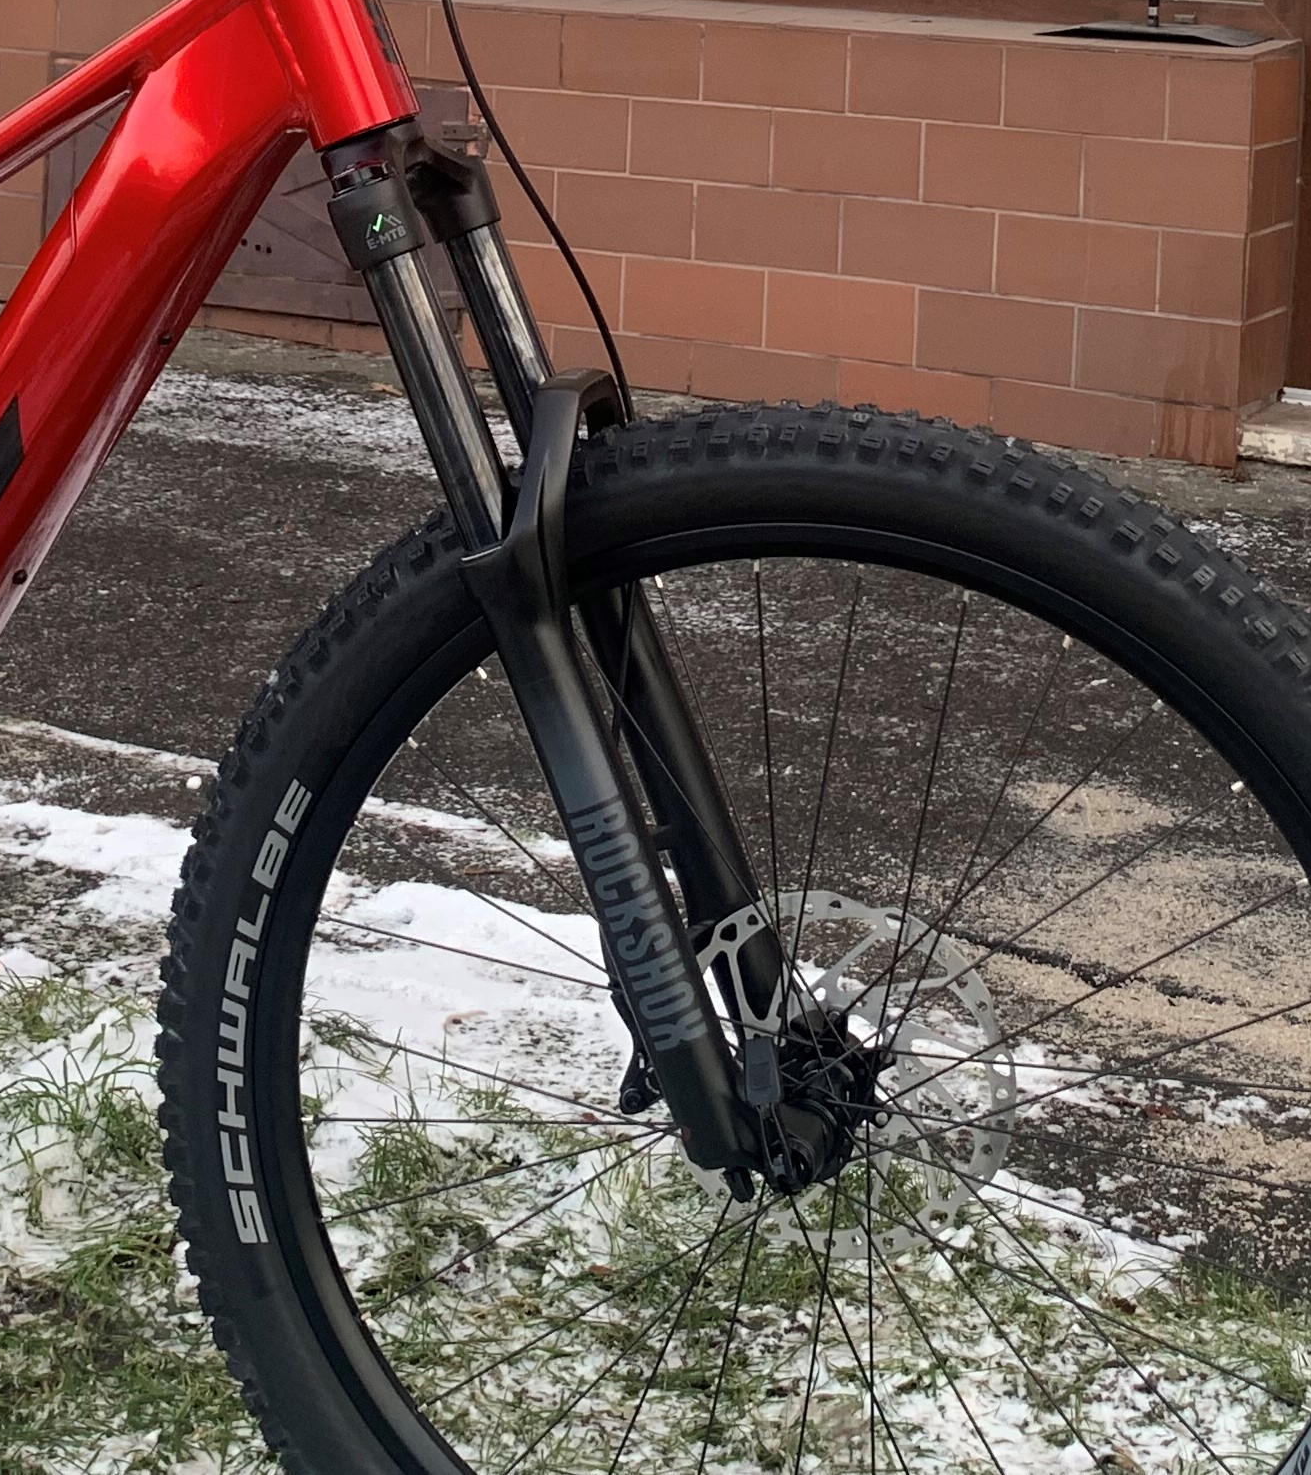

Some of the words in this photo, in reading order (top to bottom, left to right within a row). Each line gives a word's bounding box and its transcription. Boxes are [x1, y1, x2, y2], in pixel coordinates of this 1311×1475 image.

[365, 225, 407, 251] E-MTB
[216, 778, 313, 1244] SCHWALBE
[569, 800, 709, 1052] ROCKSHOX
